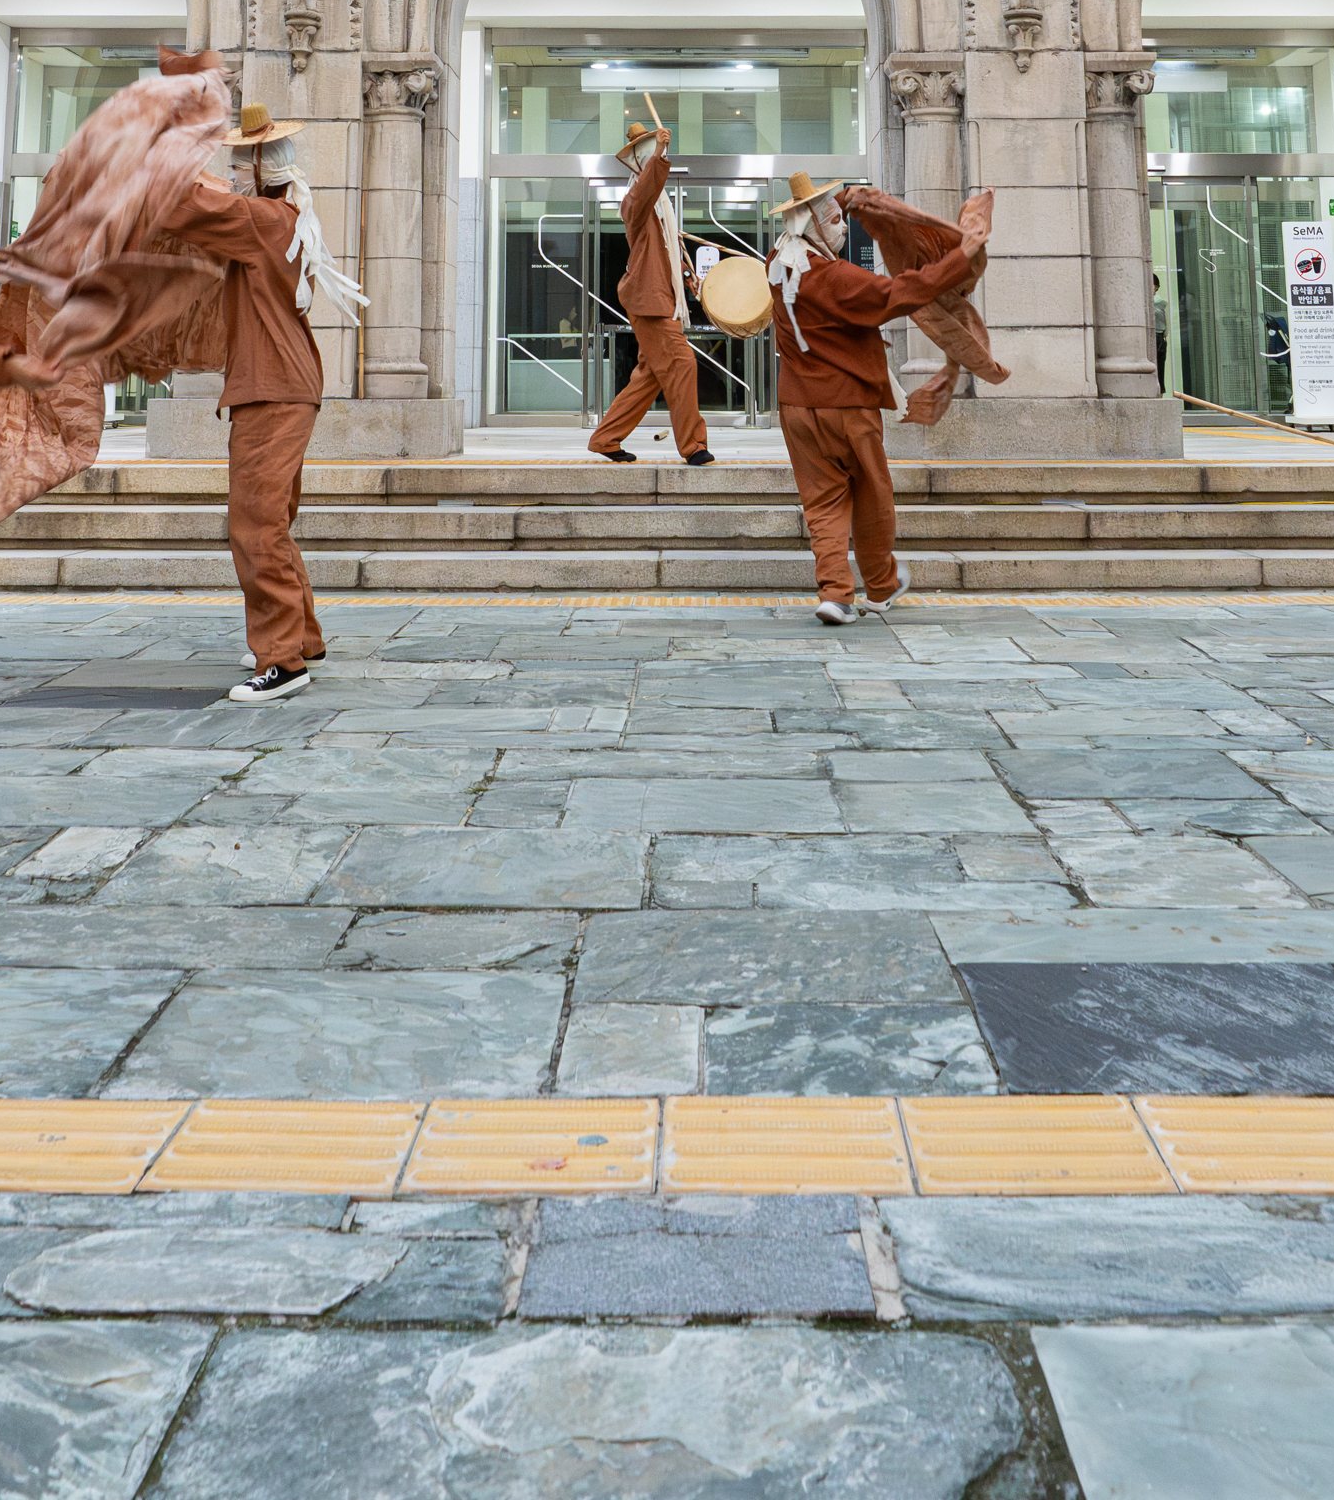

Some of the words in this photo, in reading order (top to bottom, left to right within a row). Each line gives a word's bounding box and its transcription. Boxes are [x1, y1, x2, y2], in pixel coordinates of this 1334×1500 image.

[1293, 227, 1323, 235] SeMA
[1292, 286, 1332, 295] 음식물/음료
[1298, 296, 1327, 304] 반입불가
